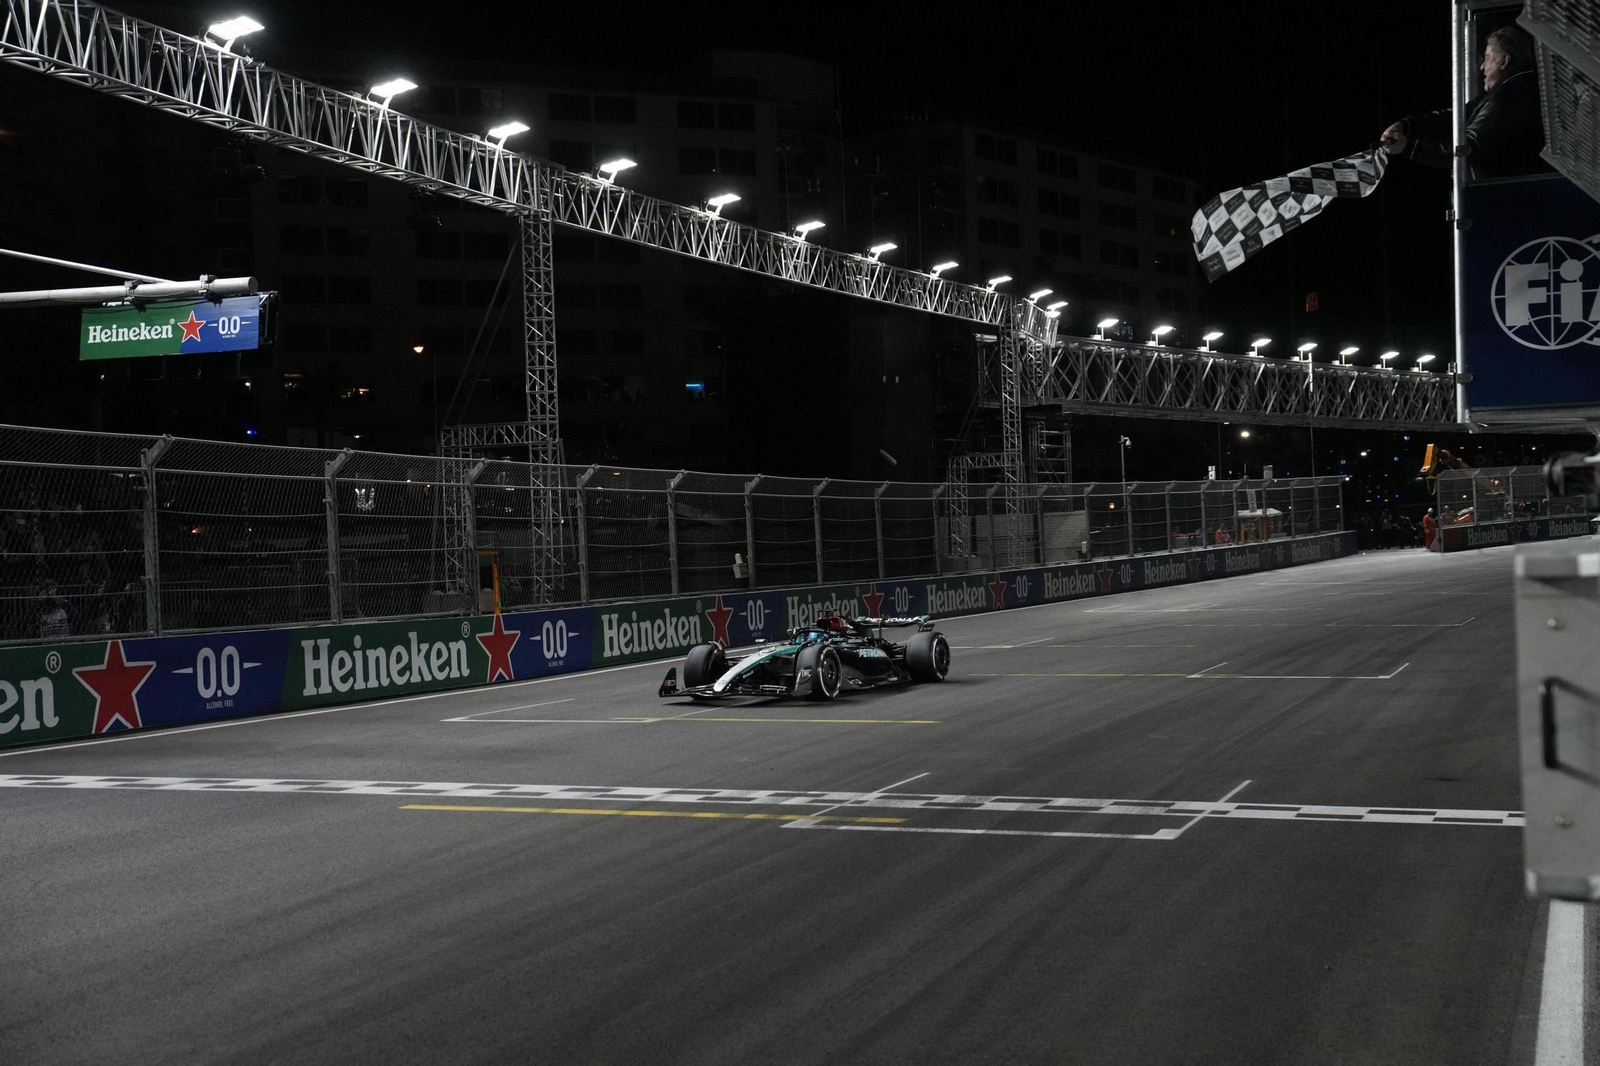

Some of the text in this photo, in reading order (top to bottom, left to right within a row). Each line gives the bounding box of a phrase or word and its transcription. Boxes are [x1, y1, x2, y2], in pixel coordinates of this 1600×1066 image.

[1505, 259, 1600, 326] Fi
[87, 315, 241, 344] Heineken 0.0
[1468, 526, 1508, 546] Heineken
[1549, 519, 1589, 537] Heineken
[1043, 569, 1096, 599] Heineken
[1144, 559, 1187, 585] Heineken
[894, 586, 909, 613] 0.0
[926, 581, 987, 614] Heineken
[601, 599, 764, 658] Heineken 0.0
[196, 645, 241, 699] 0.0
[301, 619, 568, 697] Heineken 0.0
[206, 699, 234, 710] ALCOHOL FREE
